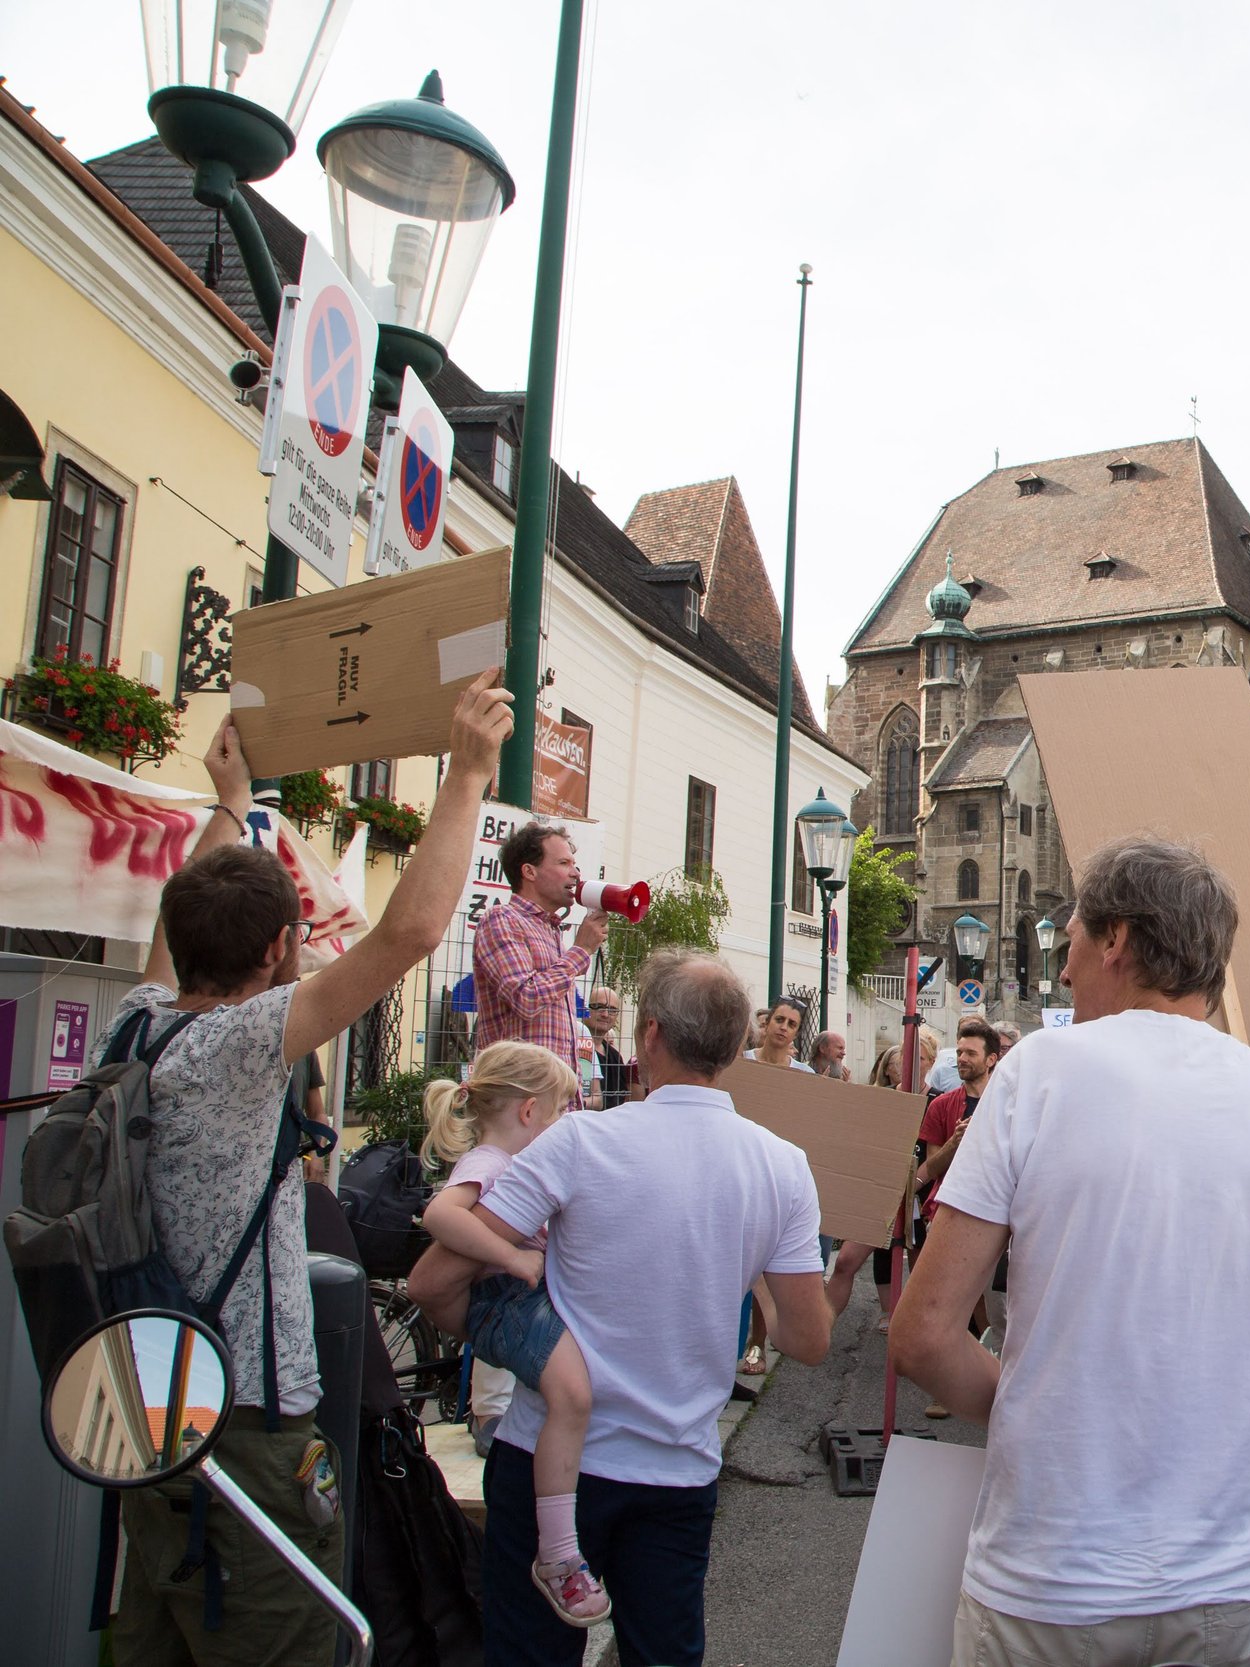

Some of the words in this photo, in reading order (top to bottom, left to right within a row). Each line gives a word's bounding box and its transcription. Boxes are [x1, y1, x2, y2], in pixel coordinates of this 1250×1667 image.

[314, 422, 335, 455] ENDE
[281, 436, 295, 463] gilt
[295, 447, 306, 474] für
[306, 460, 316, 485] die
[316, 475, 336, 504] ganze
[335, 488, 352, 520] Reihe
[299, 482, 331, 528] Mittwochs
[323, 534, 335, 560] Uhr
[407, 523, 422, 549] ENDE
[382, 539, 393, 562] gilt
[392, 547, 401, 569] für
[338, 646, 348, 706] FRAGIL
[350, 655, 360, 692] MUY
[916, 998, 937, 1007] ONE
